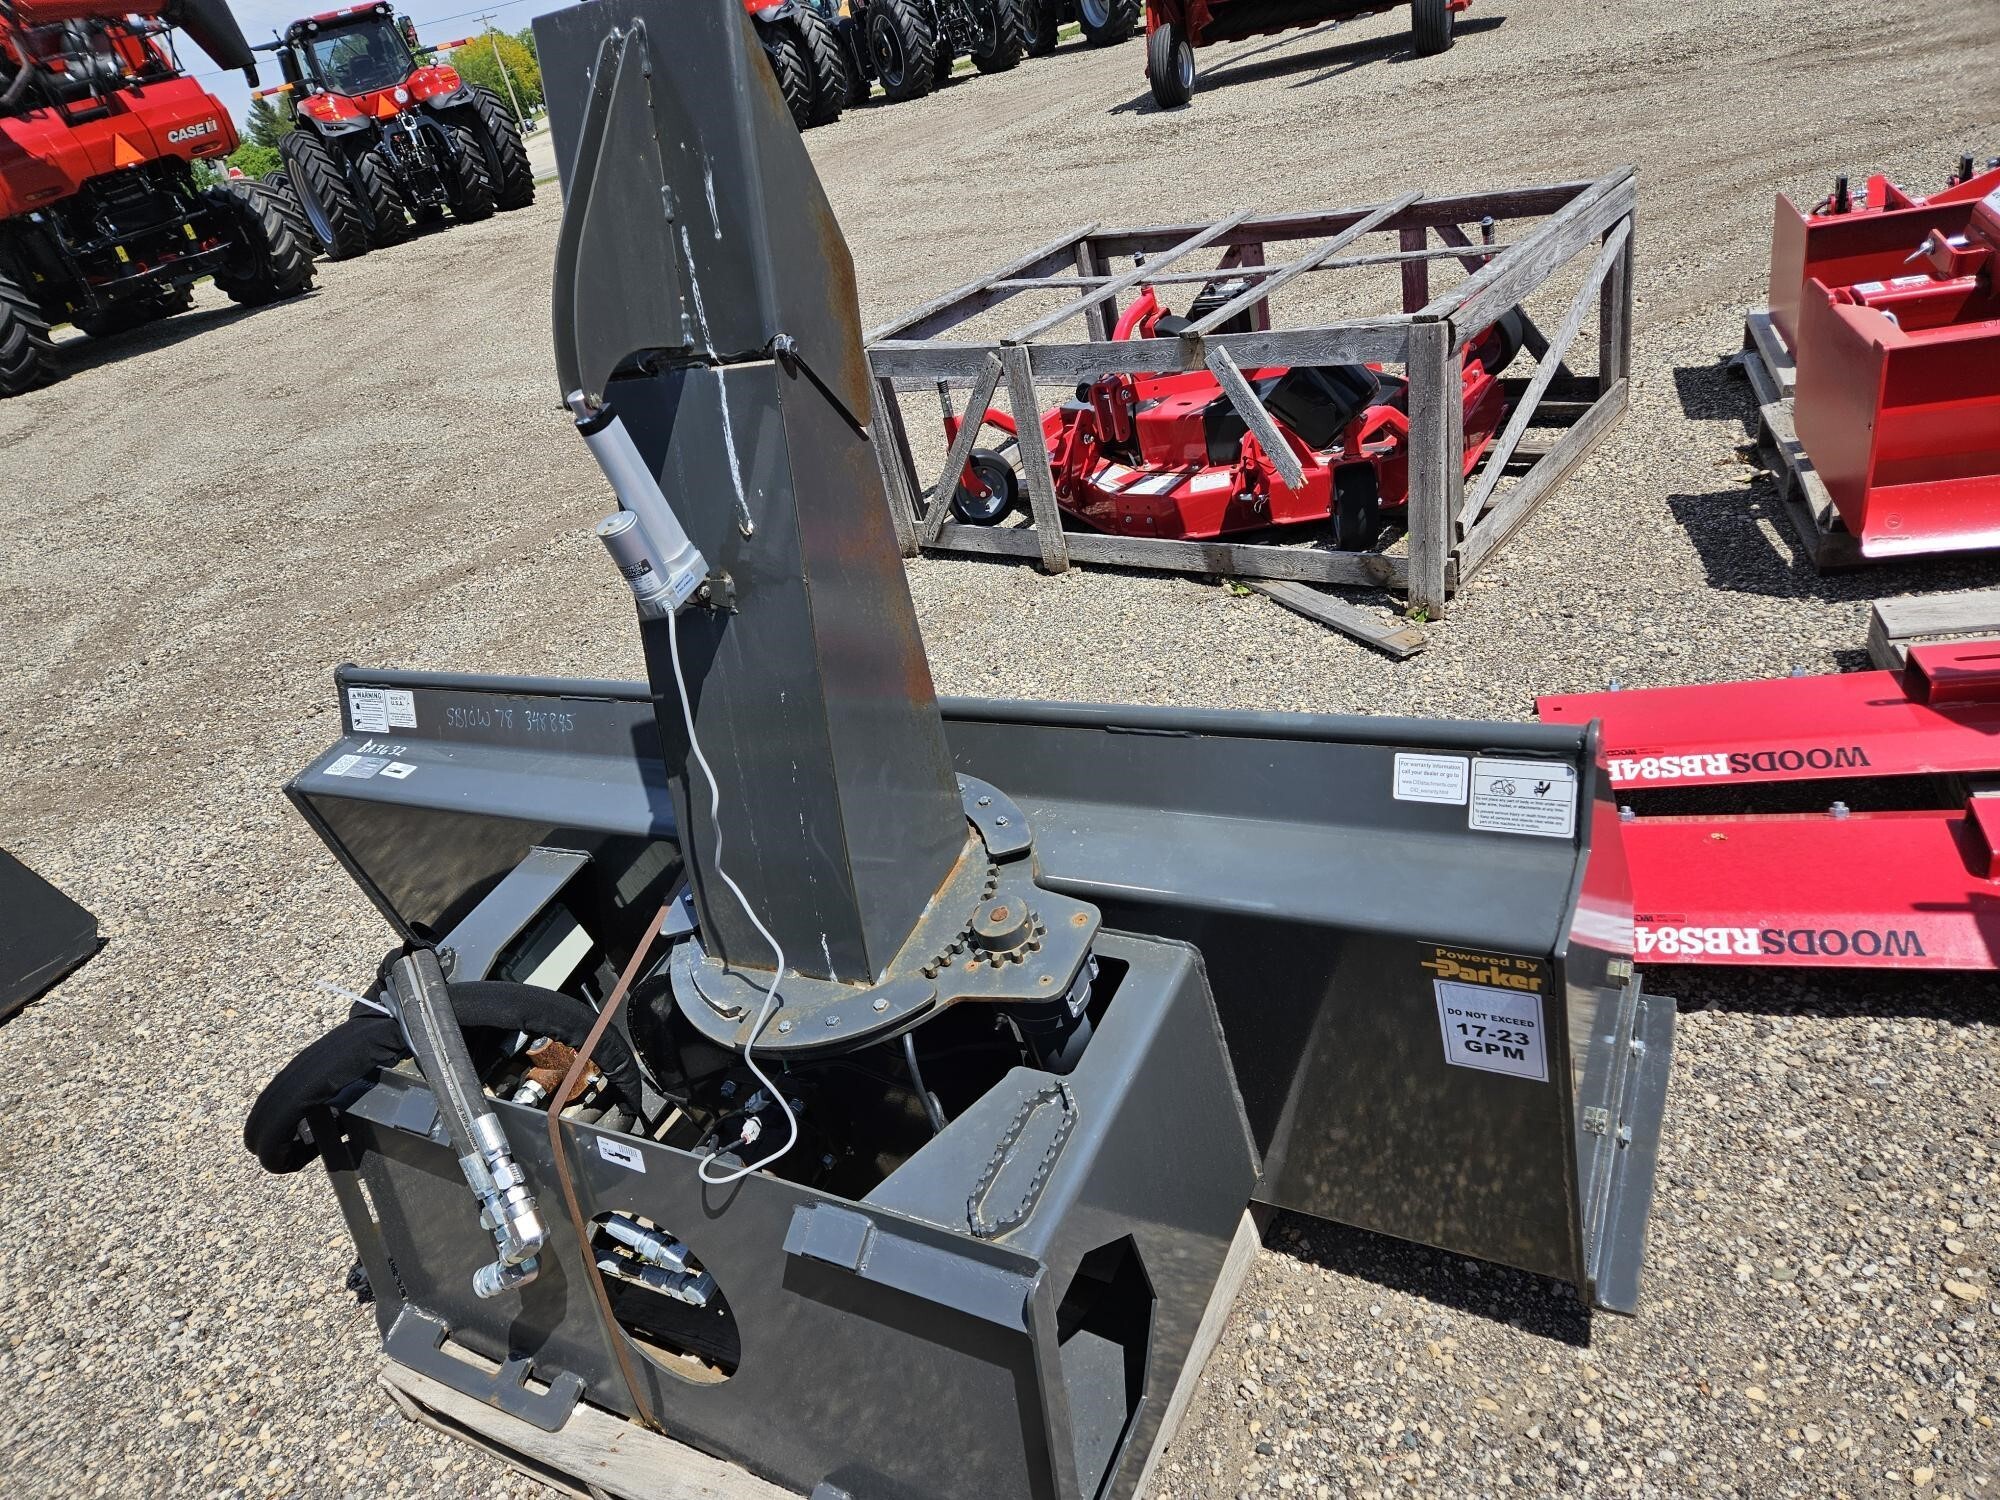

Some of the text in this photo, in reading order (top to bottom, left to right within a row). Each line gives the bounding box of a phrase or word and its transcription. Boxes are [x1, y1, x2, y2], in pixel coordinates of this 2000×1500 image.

[168, 124, 205, 143] CASE
[495, 709, 513, 729] 78
[1606, 749, 1637, 757] WOOD
[1729, 746, 1871, 773] WOODS
[1634, 926, 1927, 957] WOODS RBS84
[1436, 948, 1538, 972] Powered By
[1421, 959, 1542, 991] Parker
[1447, 1008, 1535, 1028] DO NOT EXCEED
[1457, 1023, 1530, 1046] 17-23
[1464, 1040, 1525, 1061] GPM
